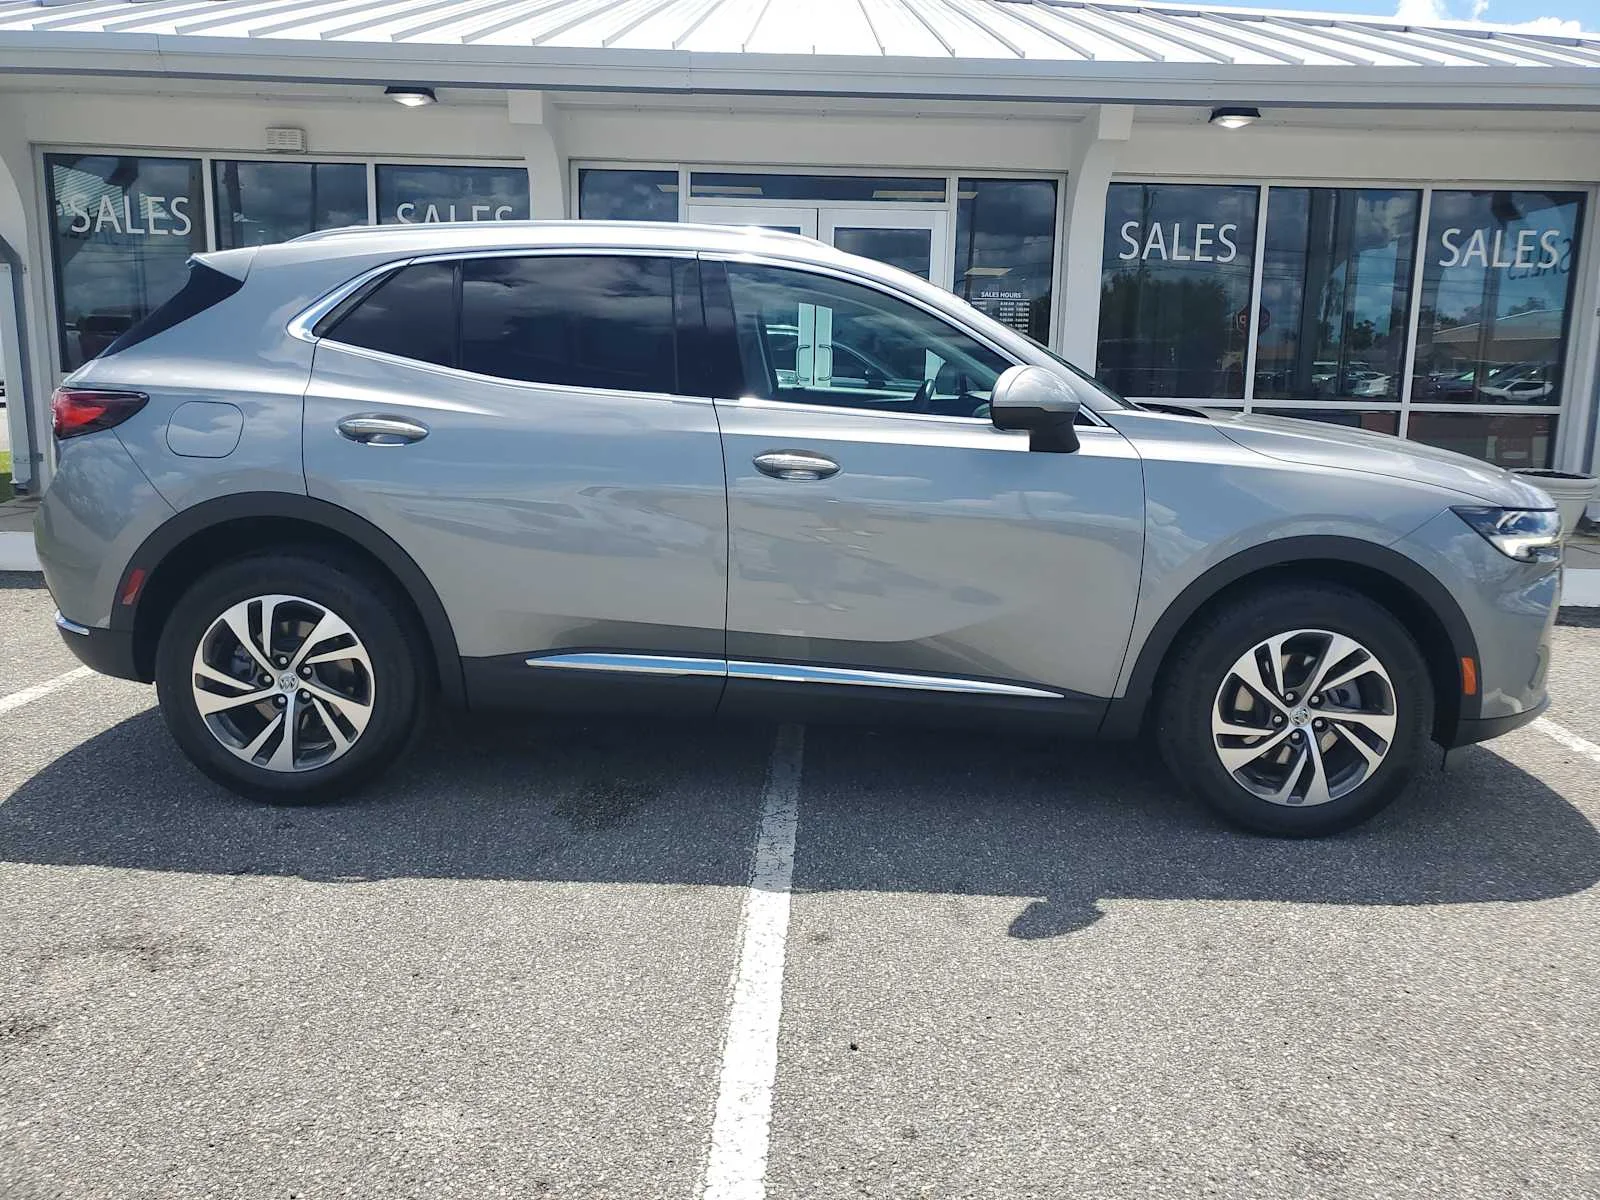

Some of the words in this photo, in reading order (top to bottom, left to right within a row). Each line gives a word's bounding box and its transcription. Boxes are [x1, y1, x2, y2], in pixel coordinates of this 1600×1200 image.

[70, 193, 192, 236] SALES
[1119, 221, 1237, 263] SALES
[1438, 228, 1561, 268] SALES
[1000, 291, 1021, 299] HOURS
